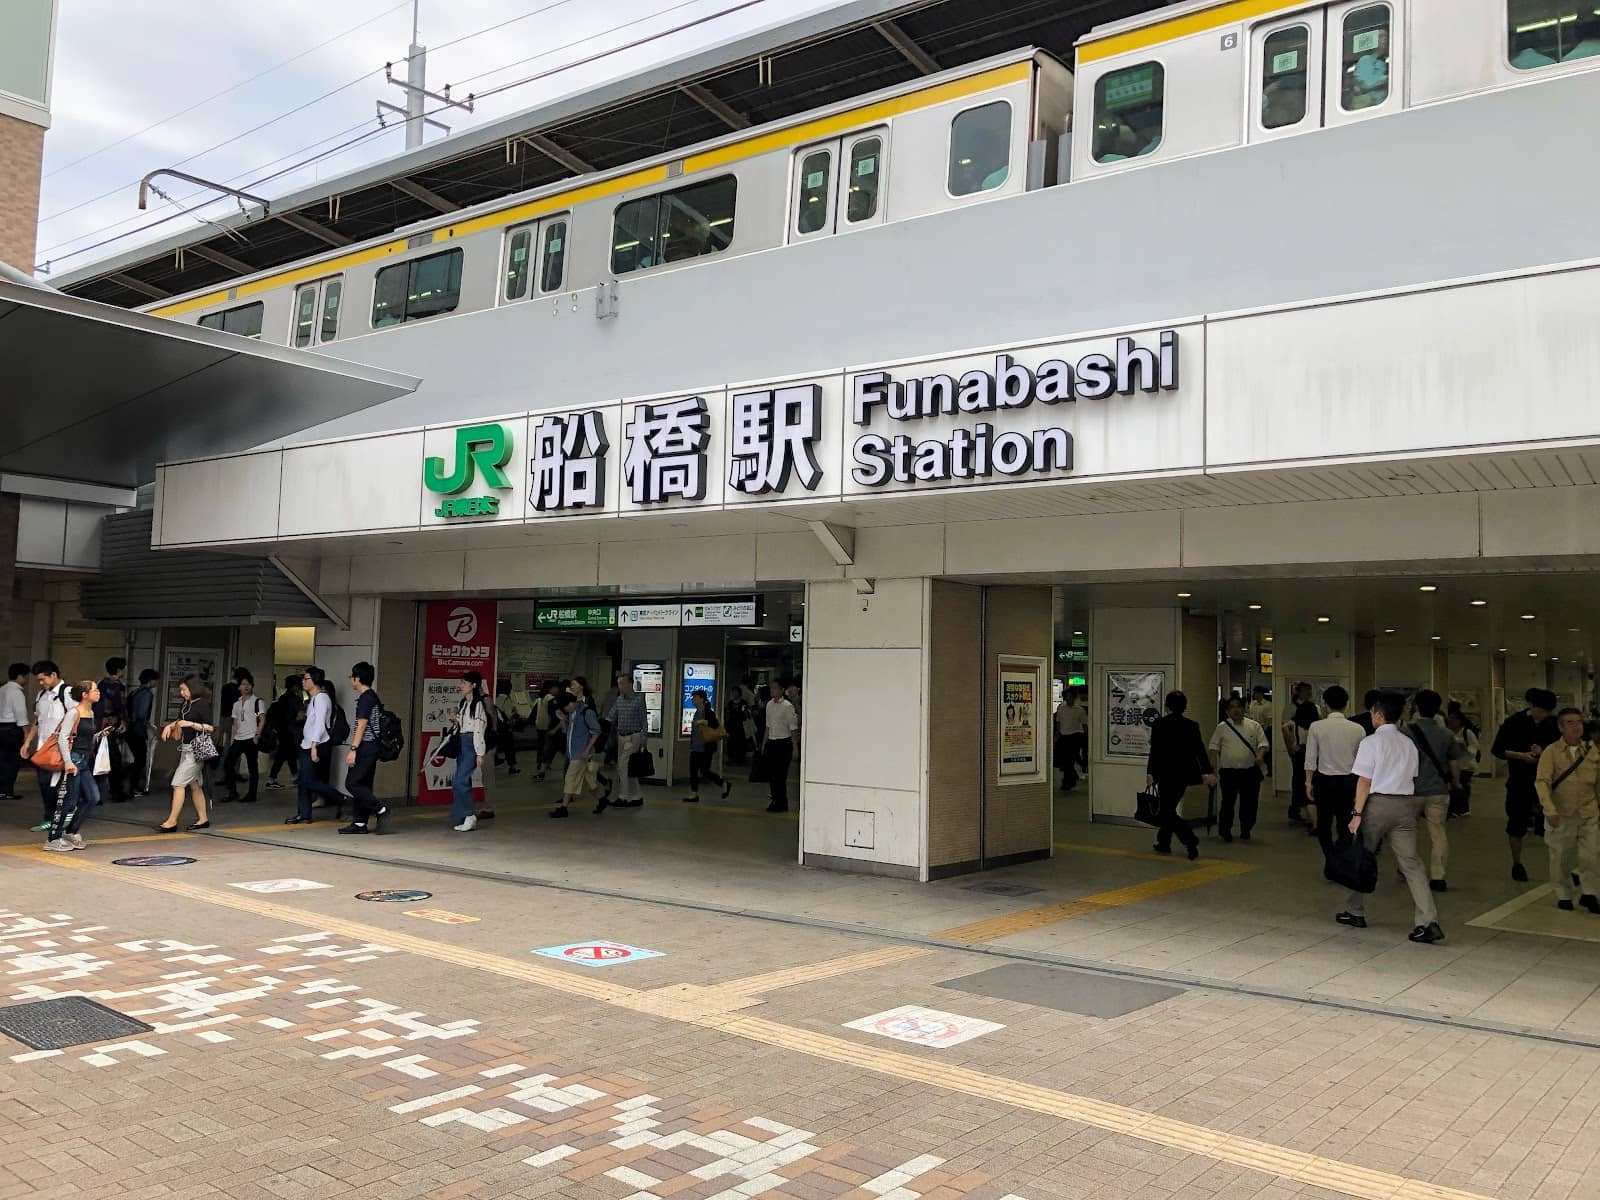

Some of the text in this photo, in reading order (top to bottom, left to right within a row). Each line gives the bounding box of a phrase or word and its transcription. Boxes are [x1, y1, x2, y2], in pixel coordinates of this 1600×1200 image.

[1224, 36, 1234, 48] 6
[852, 330, 1179, 426] Funabashi
[529, 383, 824, 512] 船橋駅
[852, 424, 1073, 487] Station
[423, 423, 514, 495] JR
[546, 609, 558, 620] JR
[432, 644, 490, 658] ビックカメラ
[437, 658, 484, 667] BicCamera.com
[1111, 707, 1143, 726] 登録
